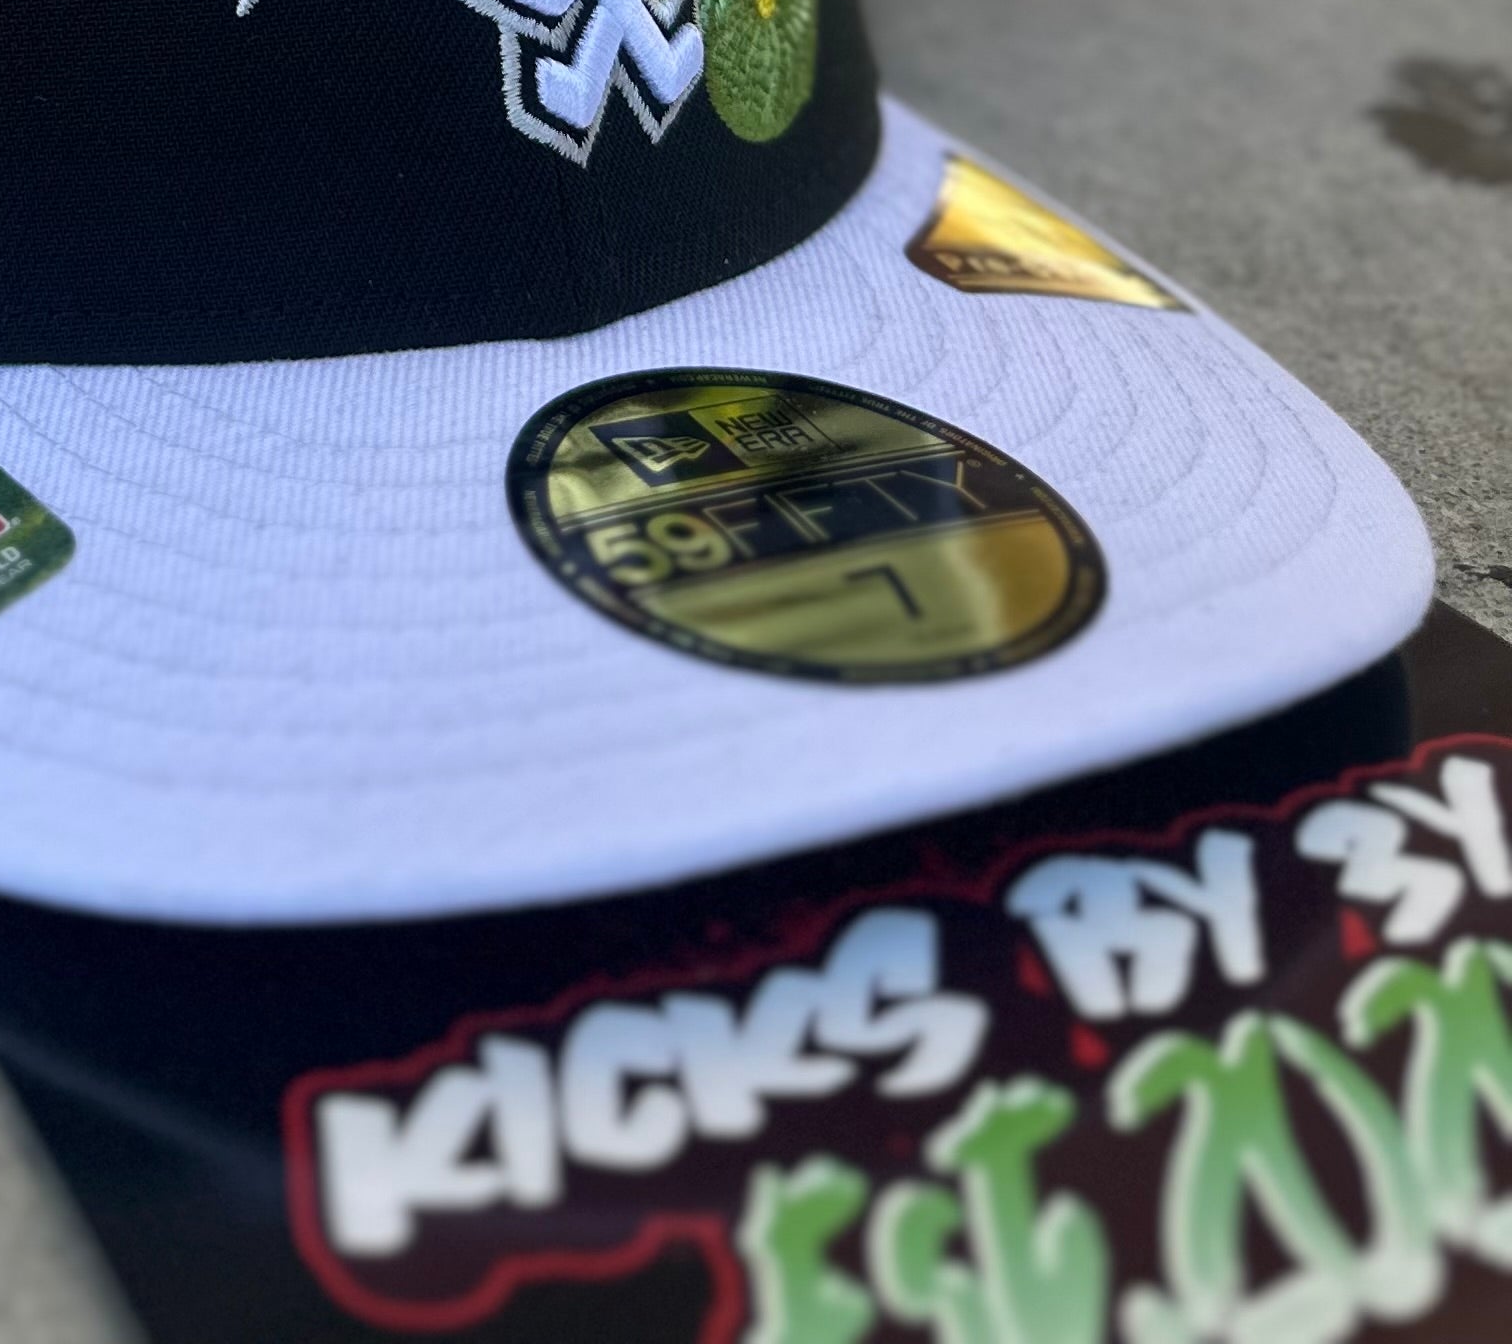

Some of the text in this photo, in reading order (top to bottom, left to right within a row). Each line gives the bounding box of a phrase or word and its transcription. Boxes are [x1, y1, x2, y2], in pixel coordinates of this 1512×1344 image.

[714, 406, 793, 435] NEW
[734, 425, 815, 453] ERA
[586, 460, 987, 585] 59FIFTY
[843, 563, 925, 621] 7
[317, 907, 989, 1256] KICKS
